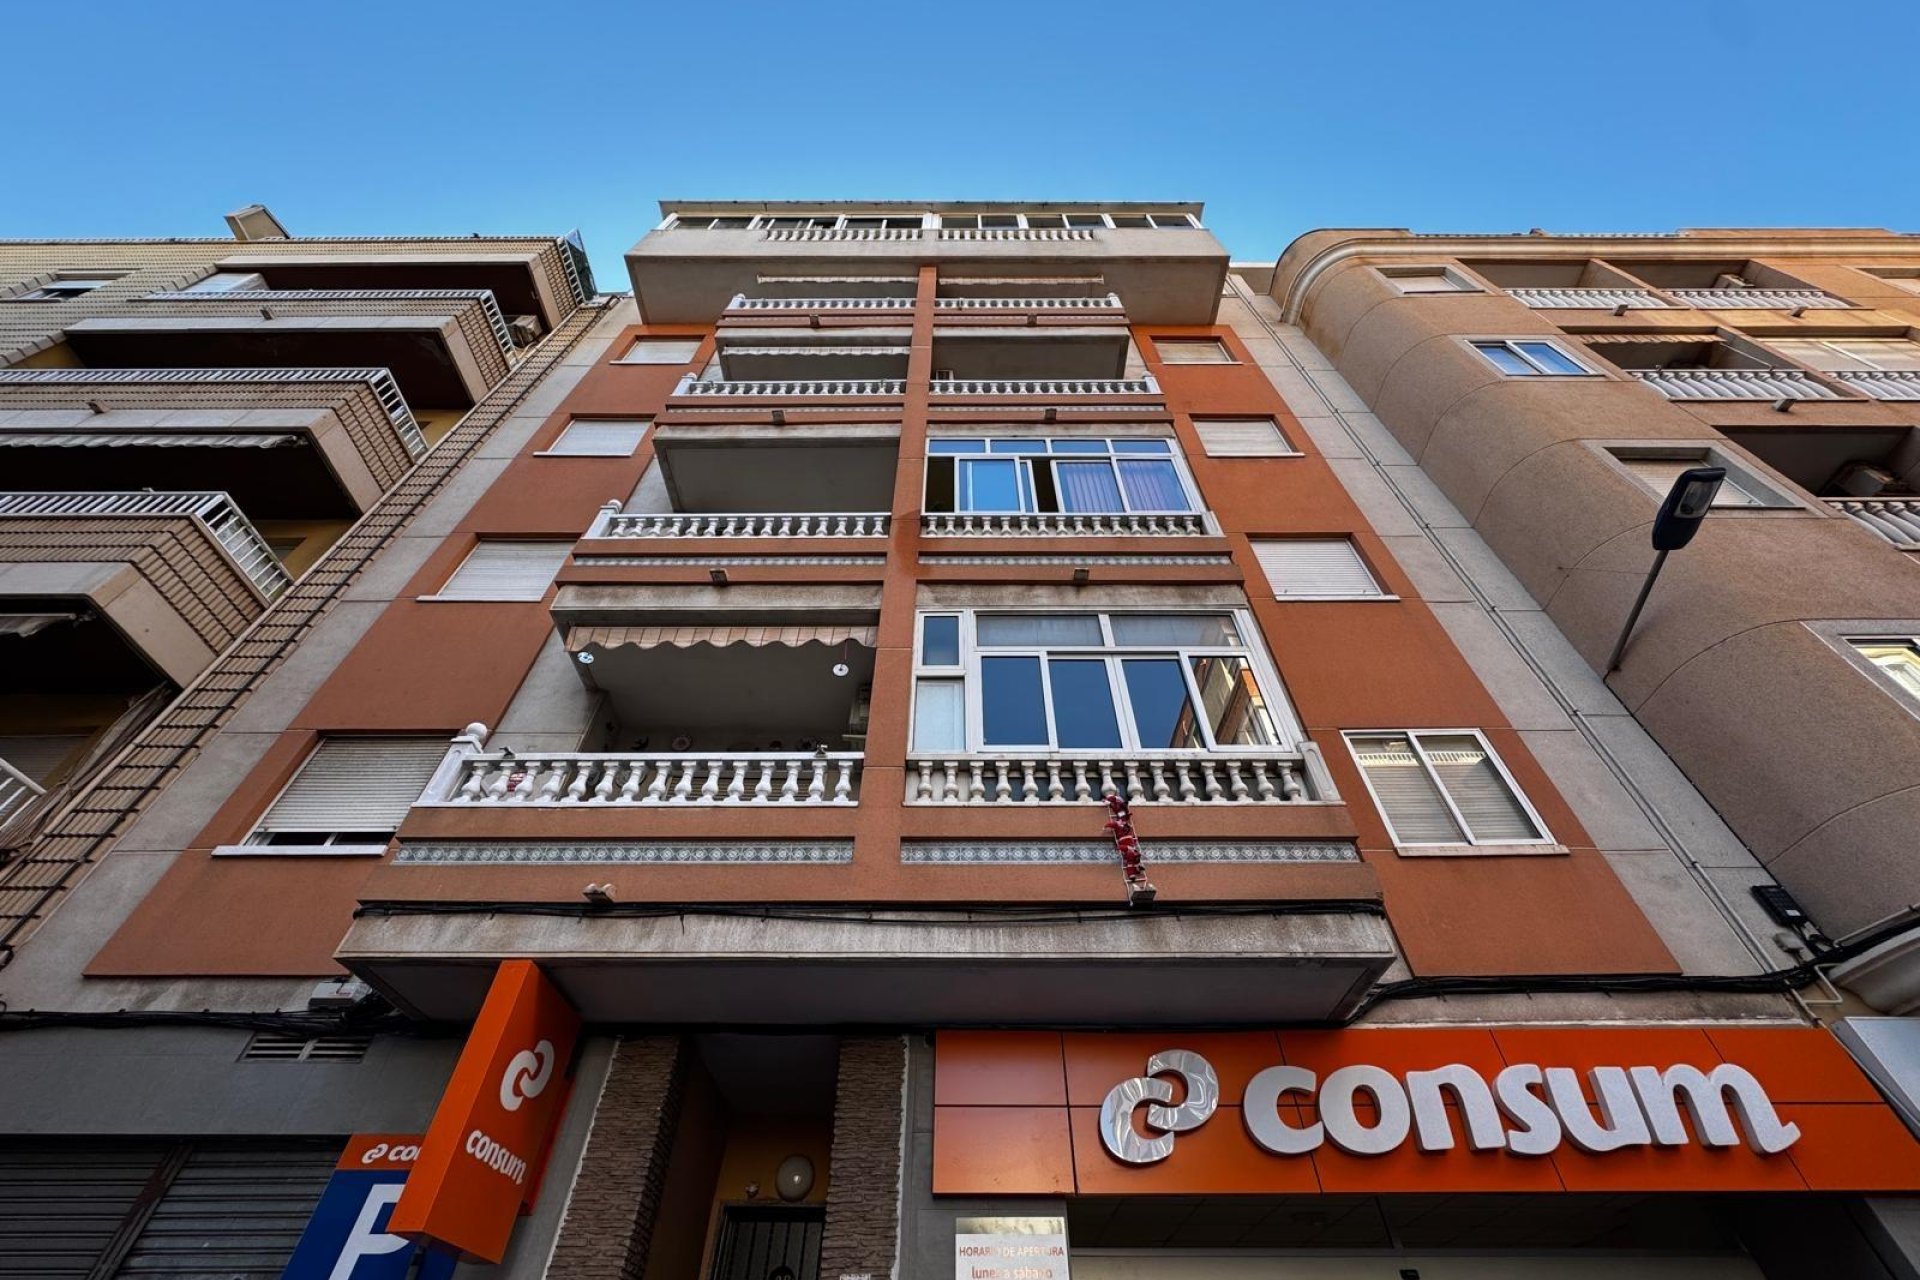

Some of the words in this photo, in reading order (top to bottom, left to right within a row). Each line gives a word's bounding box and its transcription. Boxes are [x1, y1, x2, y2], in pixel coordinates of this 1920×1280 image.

[1243, 1063, 1801, 1156] consum
[388, 1144, 421, 1162] co
[465, 1129, 527, 1185] consum
[327, 1183, 410, 1280] P
[959, 1246, 1000, 1257] HORARO
[972, 1265, 1000, 1279] lune
